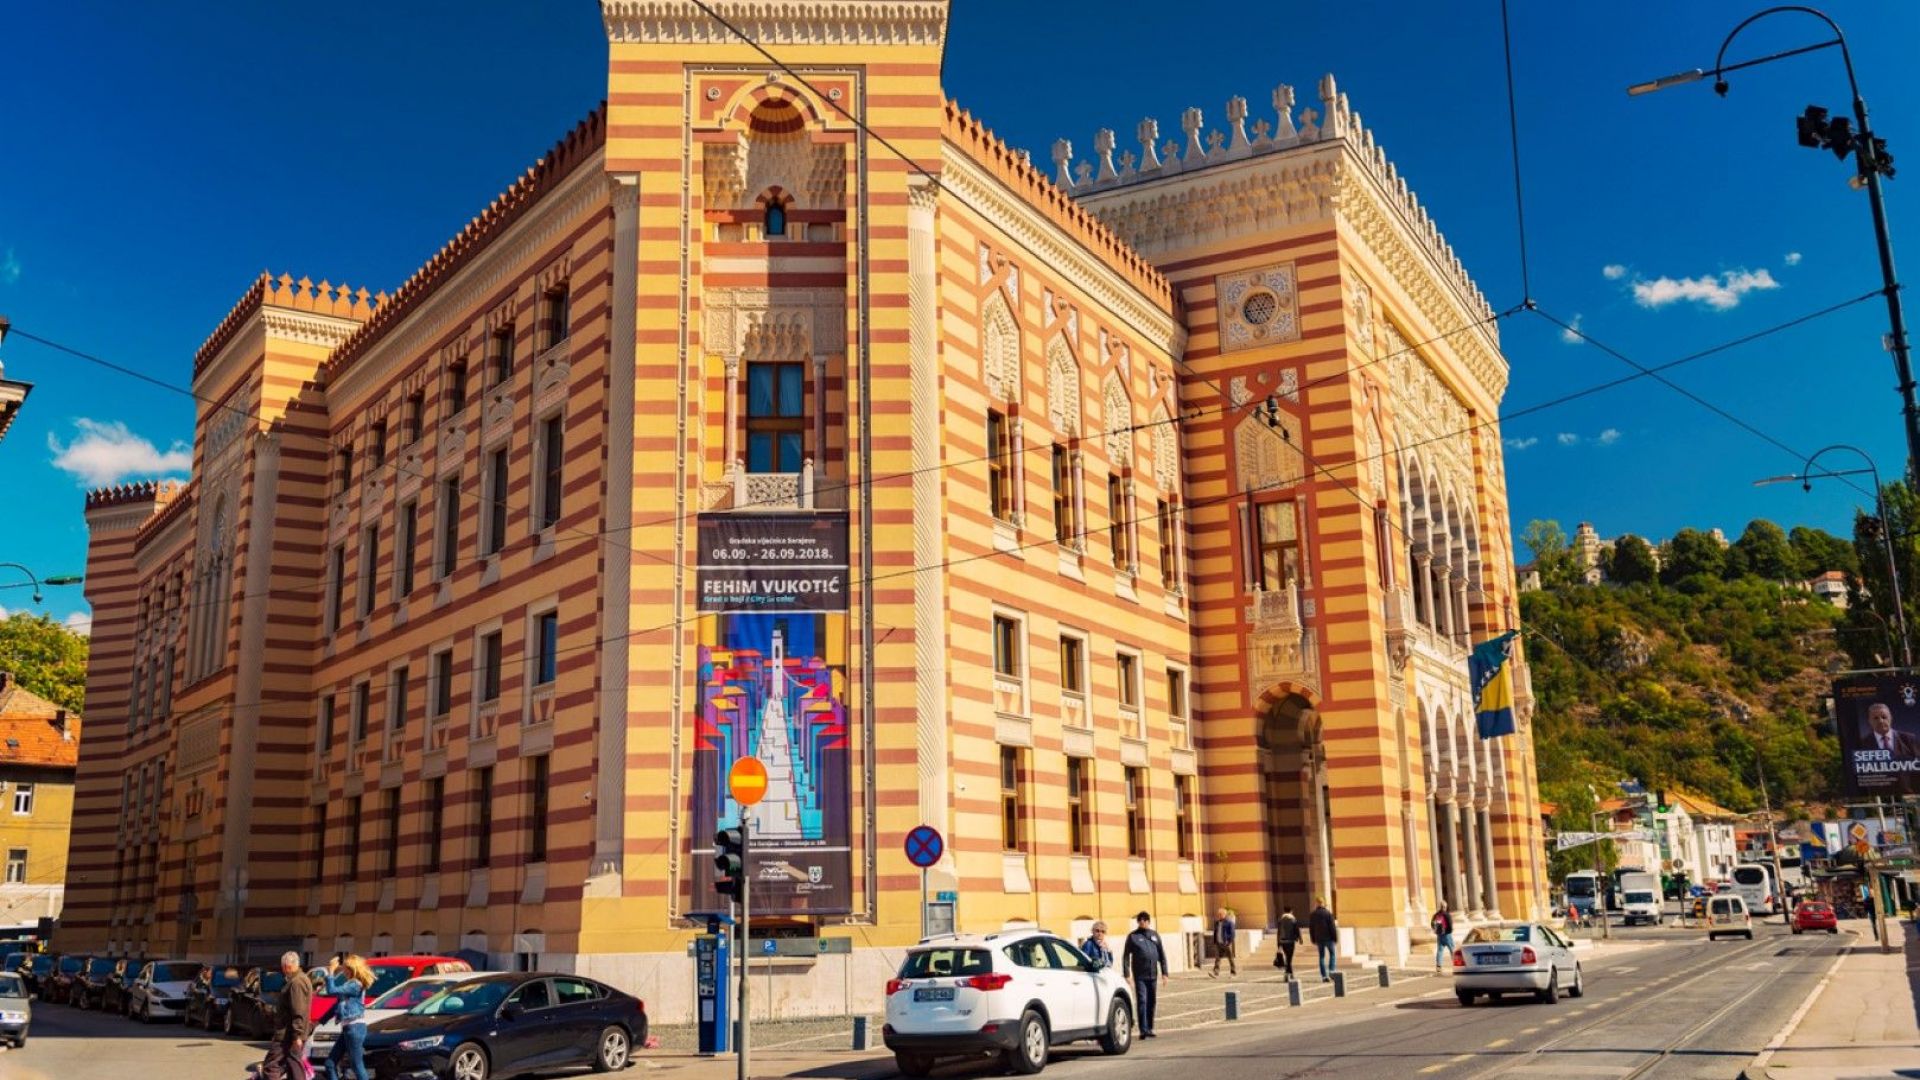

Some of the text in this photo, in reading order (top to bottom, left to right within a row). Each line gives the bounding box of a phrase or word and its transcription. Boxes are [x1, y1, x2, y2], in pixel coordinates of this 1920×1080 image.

[729, 537, 756, 545] Gradska
[787, 537, 816, 546] Sarajevo
[712, 548, 751, 560] 06.09.
[761, 548, 834, 560] 26.09.2018.
[703, 577, 840, 594] FEHIM VUKOTIĆ
[1854, 749, 1891, 762] SEFER
[1856, 758, 1920, 773] HALILOVIĆ
